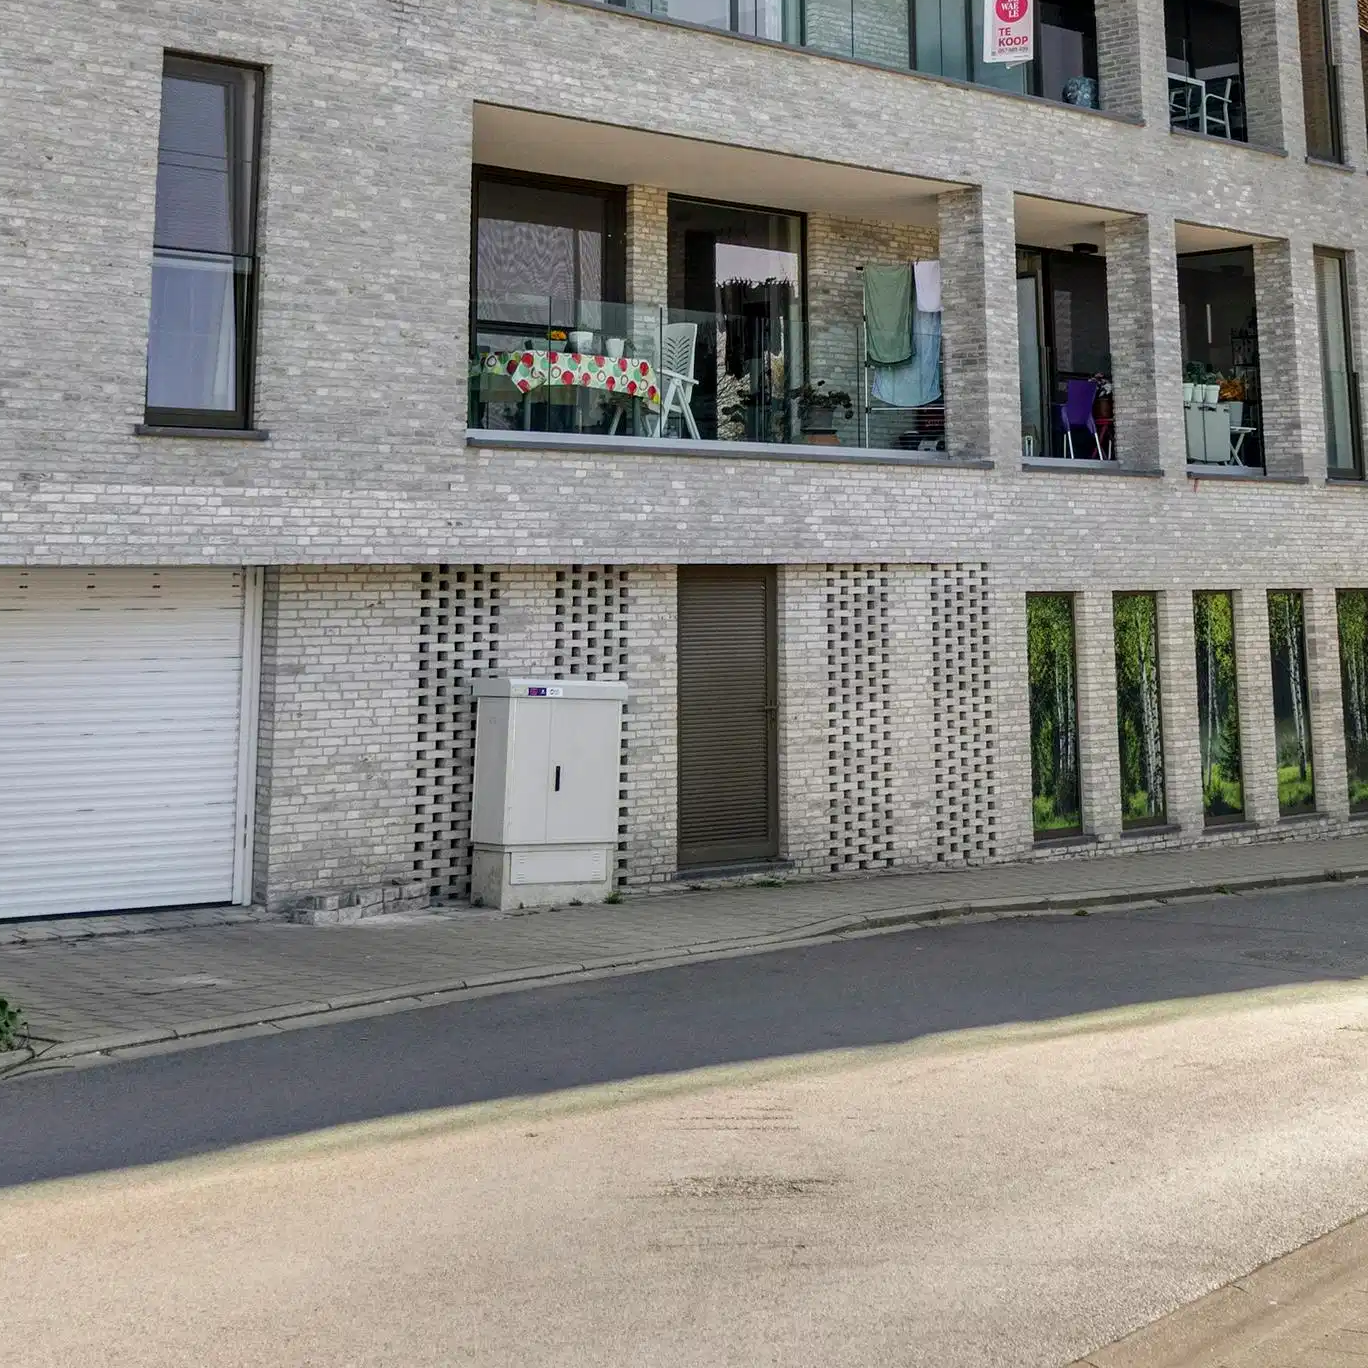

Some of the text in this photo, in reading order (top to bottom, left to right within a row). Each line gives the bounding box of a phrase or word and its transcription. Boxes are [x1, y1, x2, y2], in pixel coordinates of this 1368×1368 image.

[1001, 2, 1019, 10] WAE
[1009, 10, 1019, 18] LE
[998, 27, 1011, 36] TE
[998, 36, 1029, 47] KOOP
